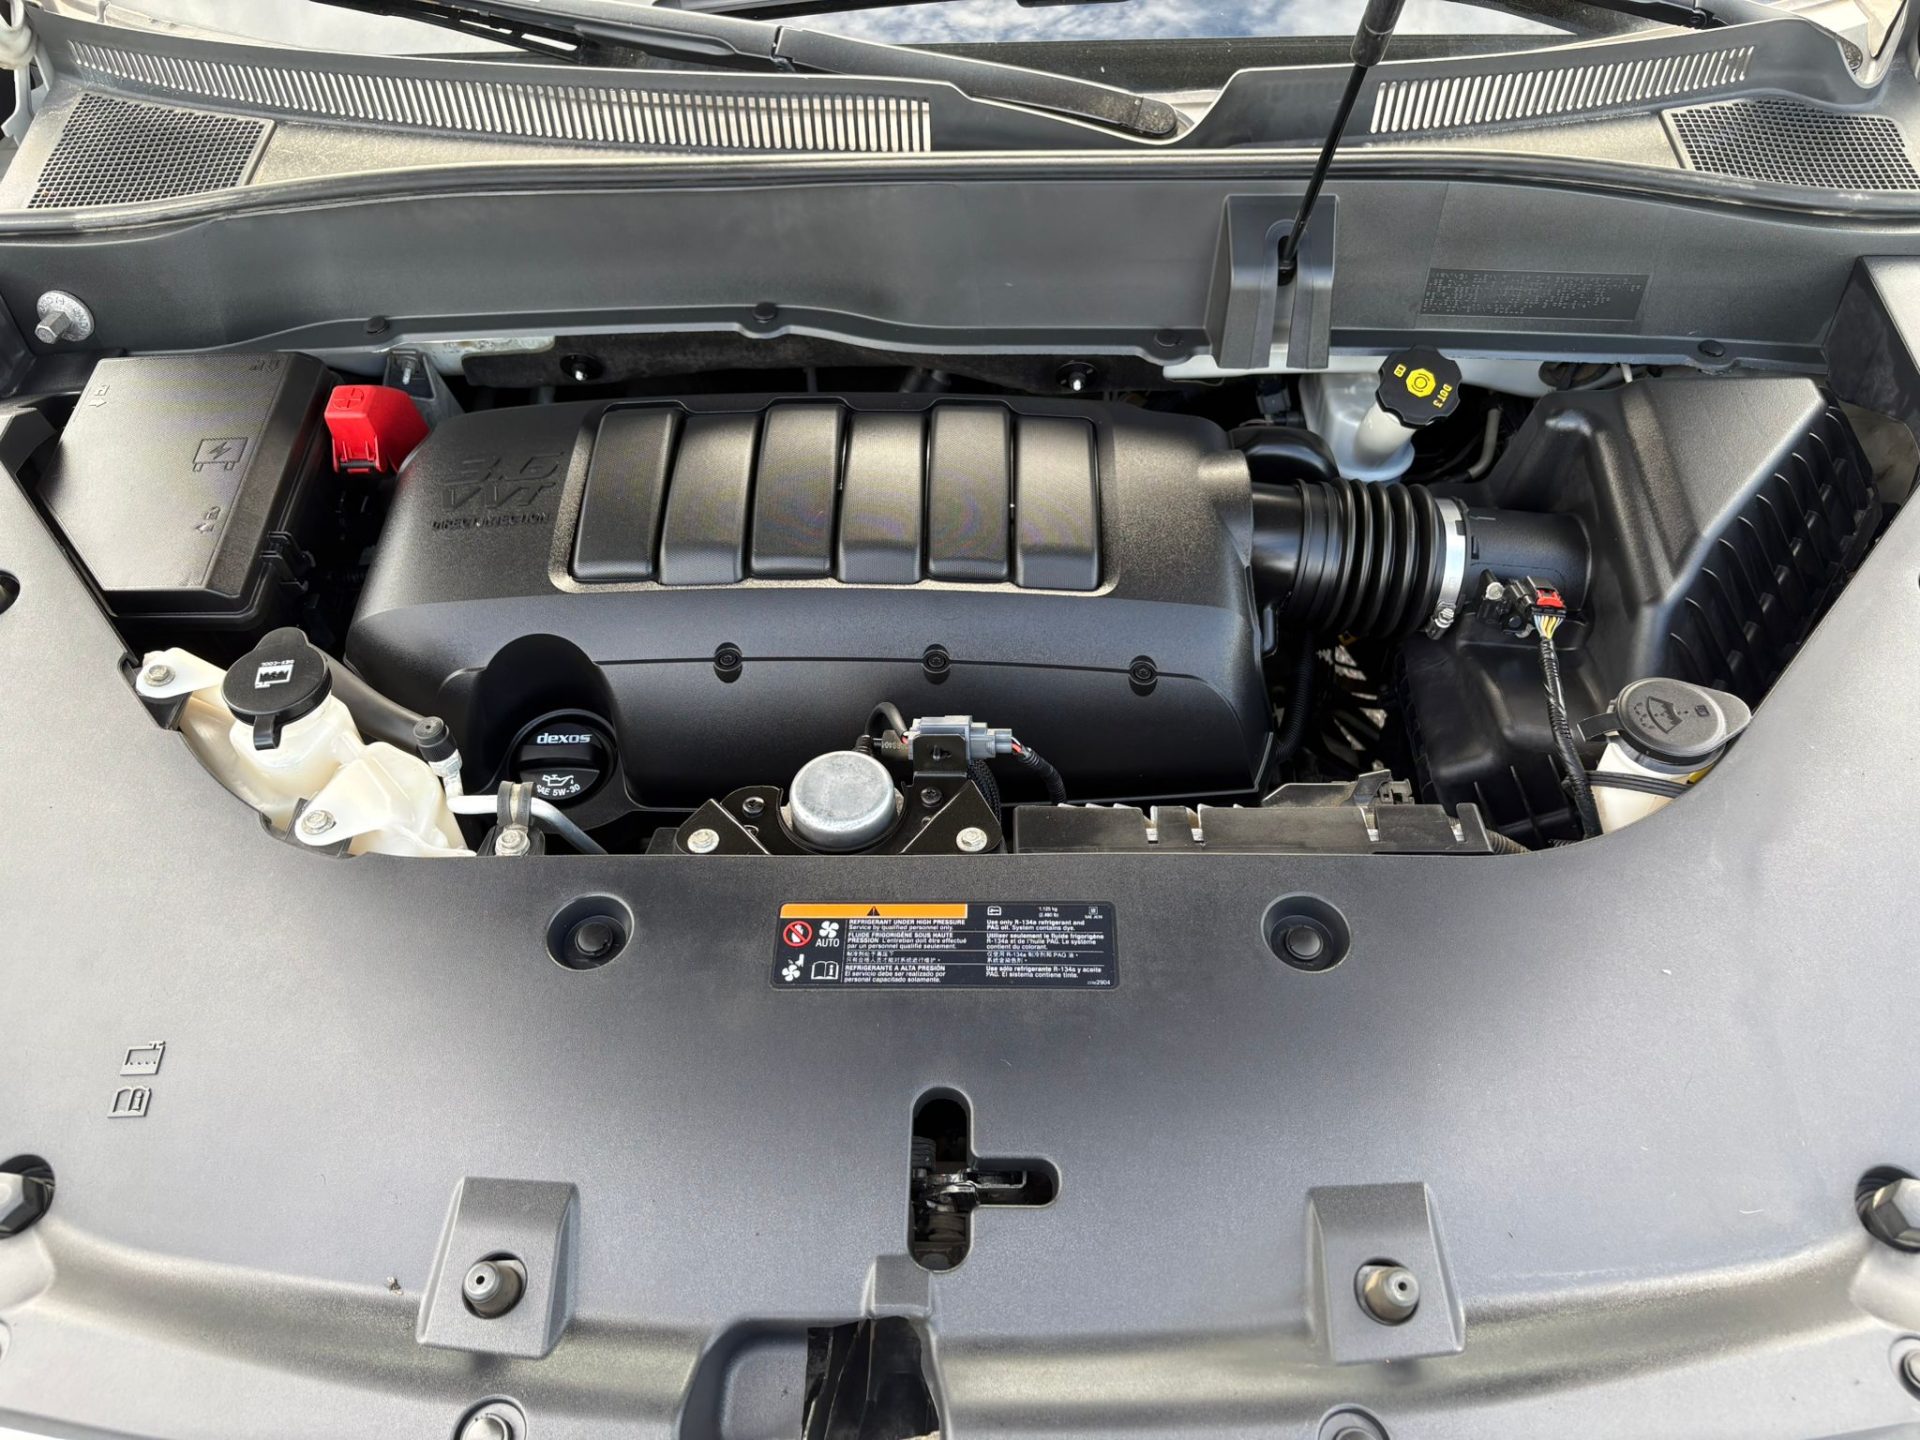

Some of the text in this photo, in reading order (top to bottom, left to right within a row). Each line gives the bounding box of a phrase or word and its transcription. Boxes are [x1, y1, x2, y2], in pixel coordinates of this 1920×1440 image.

[1437, 384, 1452, 402] DOT
[536, 733, 592, 744] dexos
[537, 784, 580, 796] SAE 5W-30
[815, 938, 840, 947] AUTO
